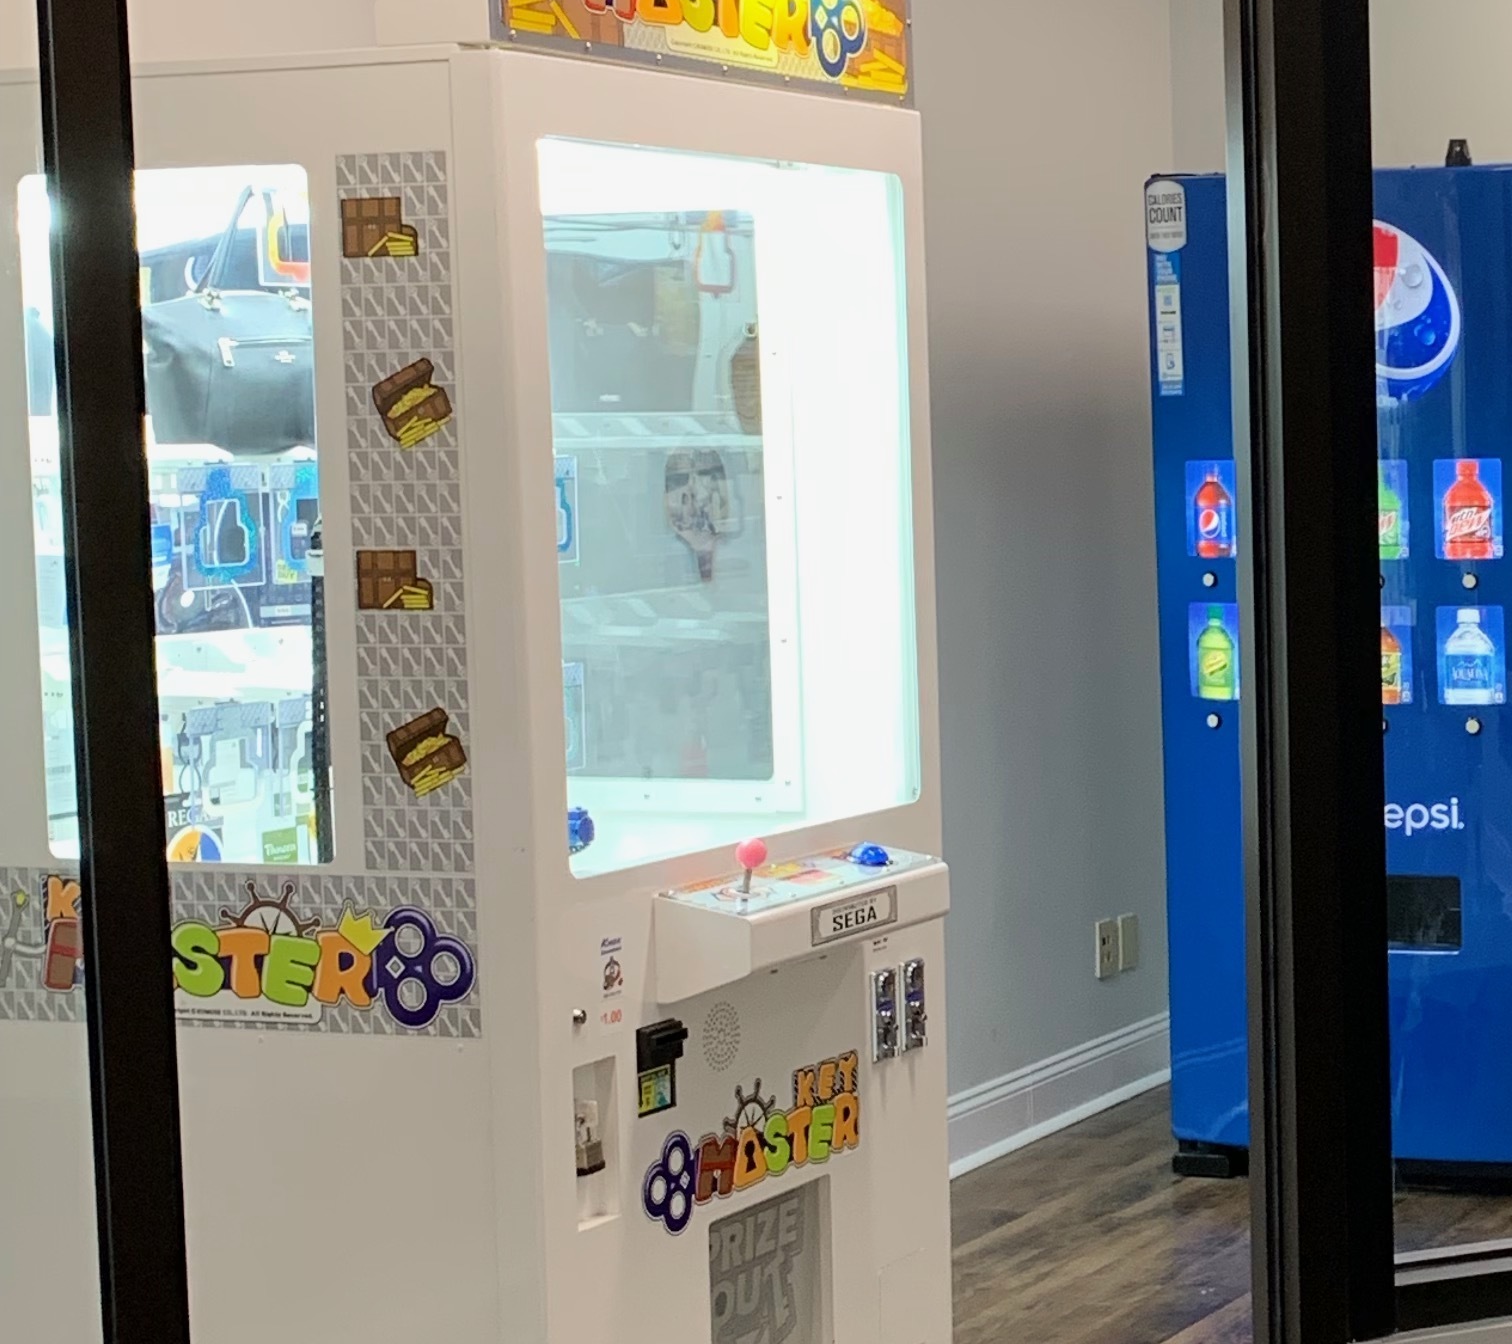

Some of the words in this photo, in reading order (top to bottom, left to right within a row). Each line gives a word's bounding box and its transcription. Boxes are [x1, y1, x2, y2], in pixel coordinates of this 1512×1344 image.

[1148, 193, 1183, 206] CALORIES
[1149, 206, 1183, 225] COUNT
[832, 905, 878, 932] SEGA
[794, 1051, 858, 1107] KEY
[696, 1092, 859, 1202] MASTER
